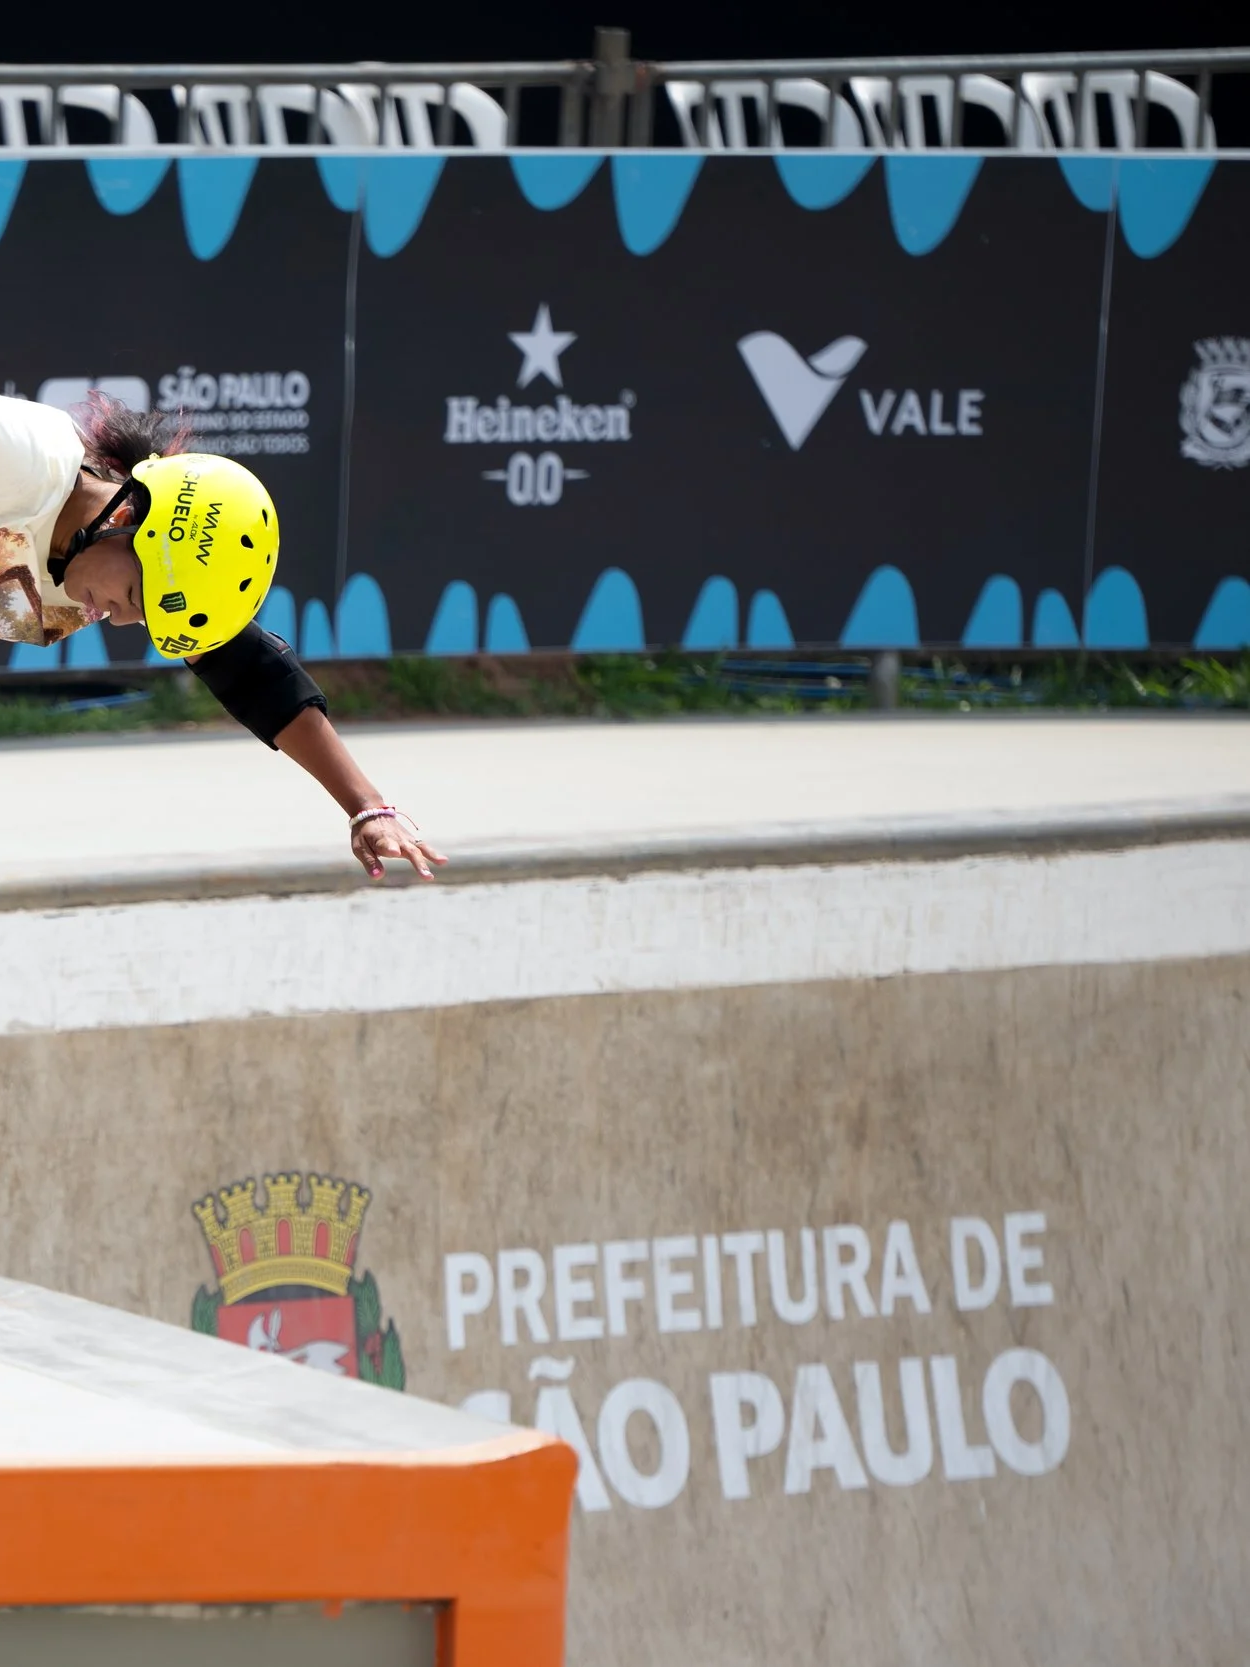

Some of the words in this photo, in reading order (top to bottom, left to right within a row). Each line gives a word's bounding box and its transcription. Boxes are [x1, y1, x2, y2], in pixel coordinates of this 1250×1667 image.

[158, 366, 217, 410] SÃO
[218, 371, 310, 410] PAULO
[859, 389, 984, 436] VALE
[443, 394, 632, 443] Heineken
[445, 1219, 931, 1351] PREFEITURA
[951, 1212, 1054, 1312] DE
[709, 1347, 1071, 1500] PAULO
